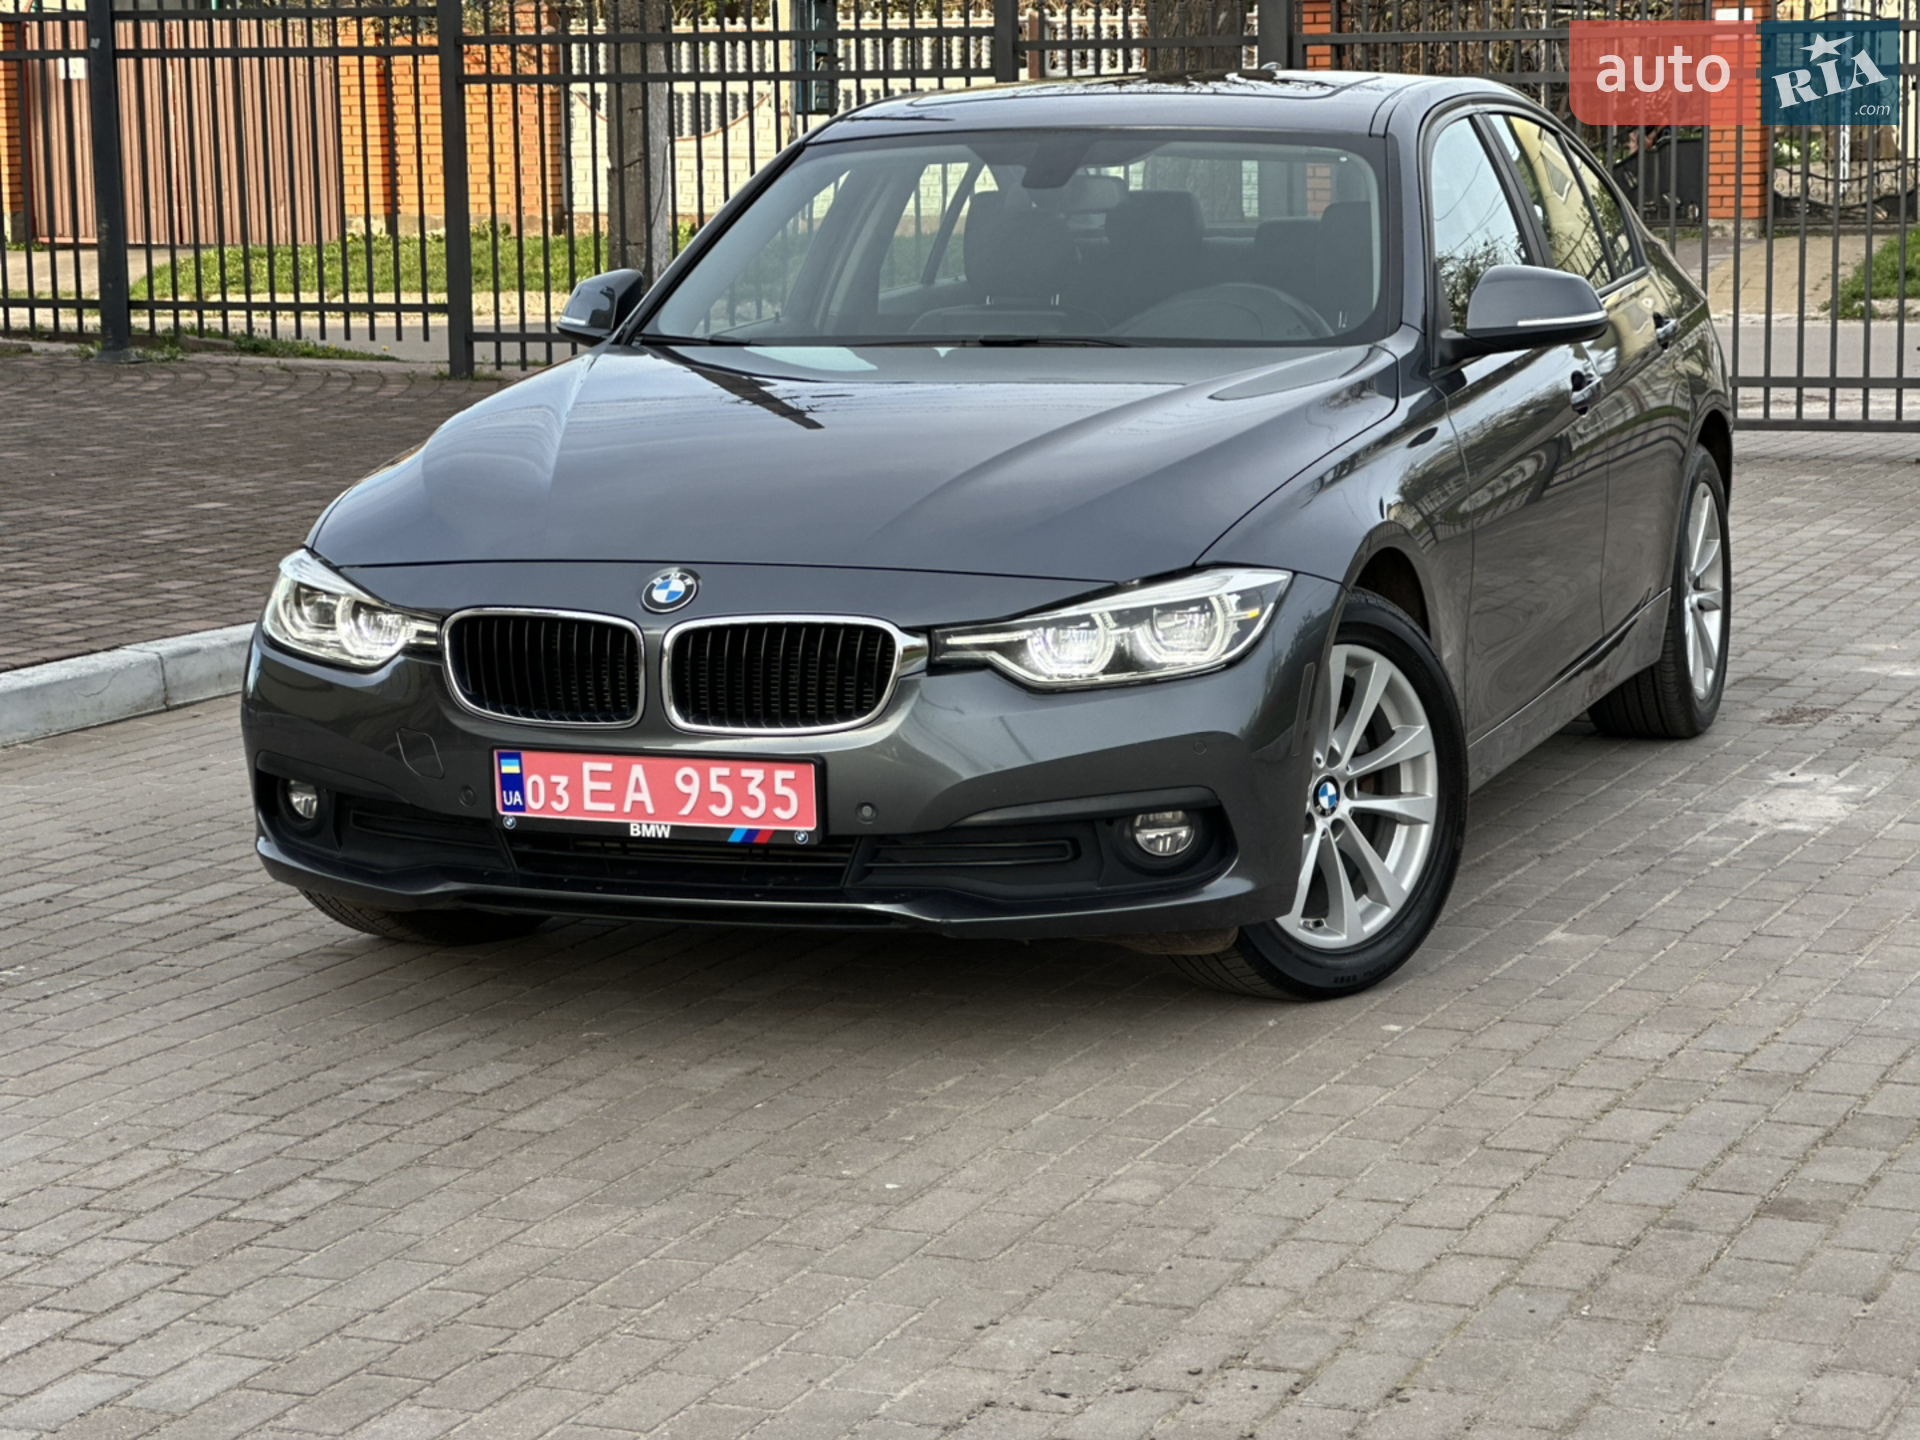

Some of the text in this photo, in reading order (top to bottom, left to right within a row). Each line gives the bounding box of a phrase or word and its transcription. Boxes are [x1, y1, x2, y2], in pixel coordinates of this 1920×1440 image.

[502, 790, 523, 806] UA
[527, 762, 799, 820] 03 EA 9535
[629, 822, 671, 838] BMW
